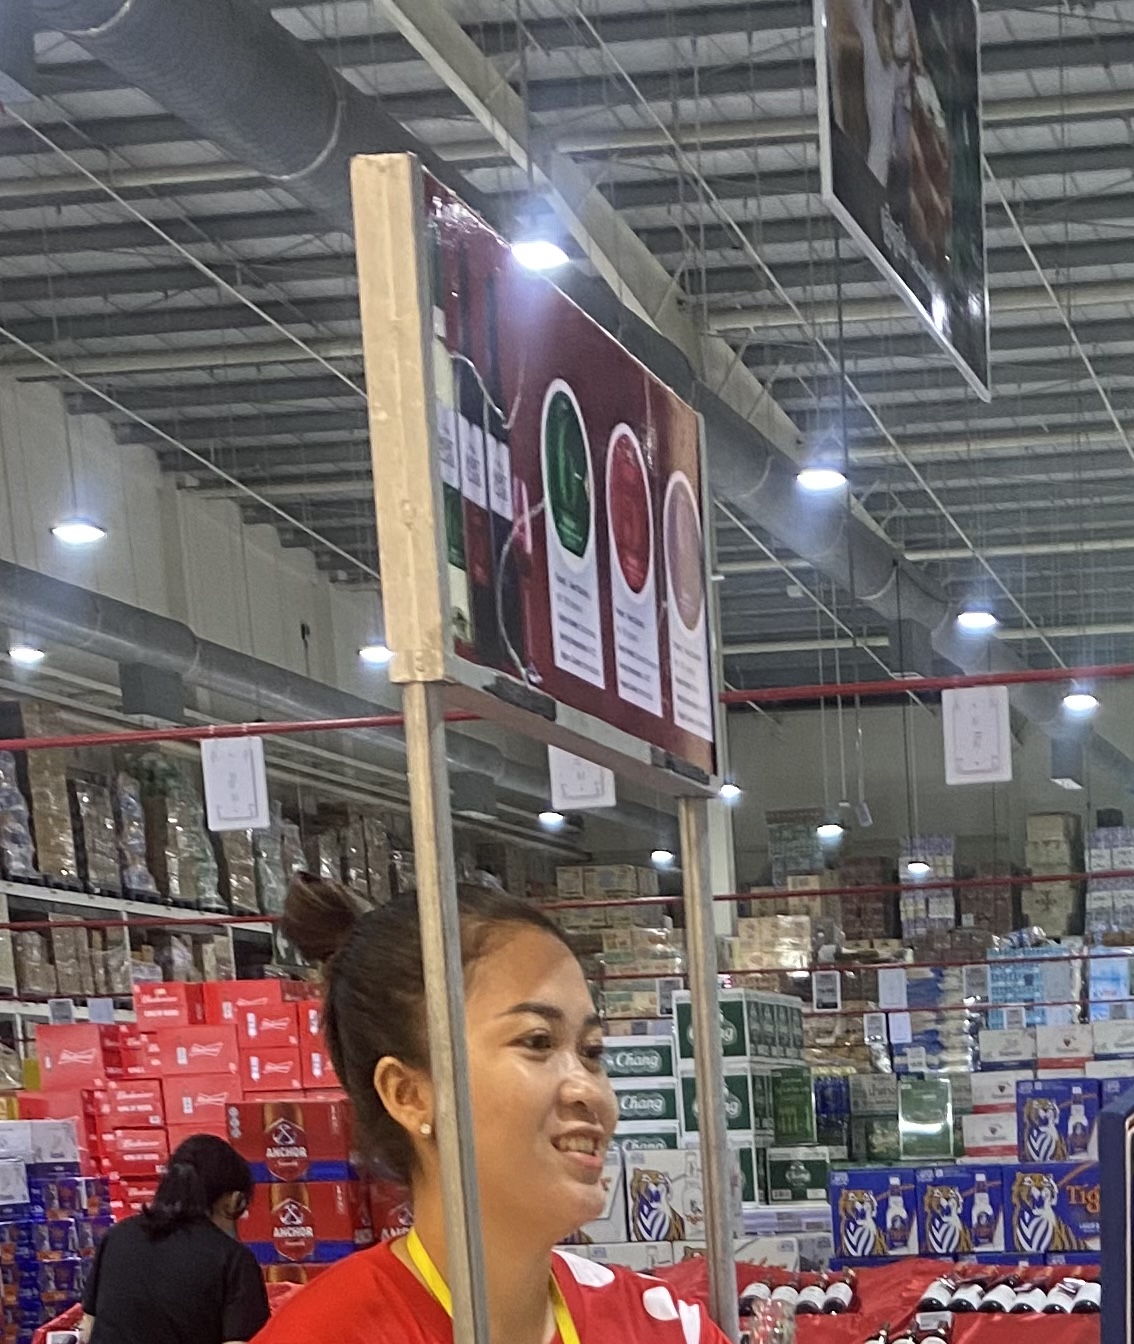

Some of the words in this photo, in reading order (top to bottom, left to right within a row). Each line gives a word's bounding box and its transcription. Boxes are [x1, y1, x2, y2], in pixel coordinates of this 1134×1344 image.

[616, 1052, 659, 1070] Chang
[621, 1095, 664, 1113] Chang
[266, 1146, 307, 1158] ANCHOR
[1066, 1185, 1100, 1212] Tig
[273, 1227, 313, 1238] ANCHOR
